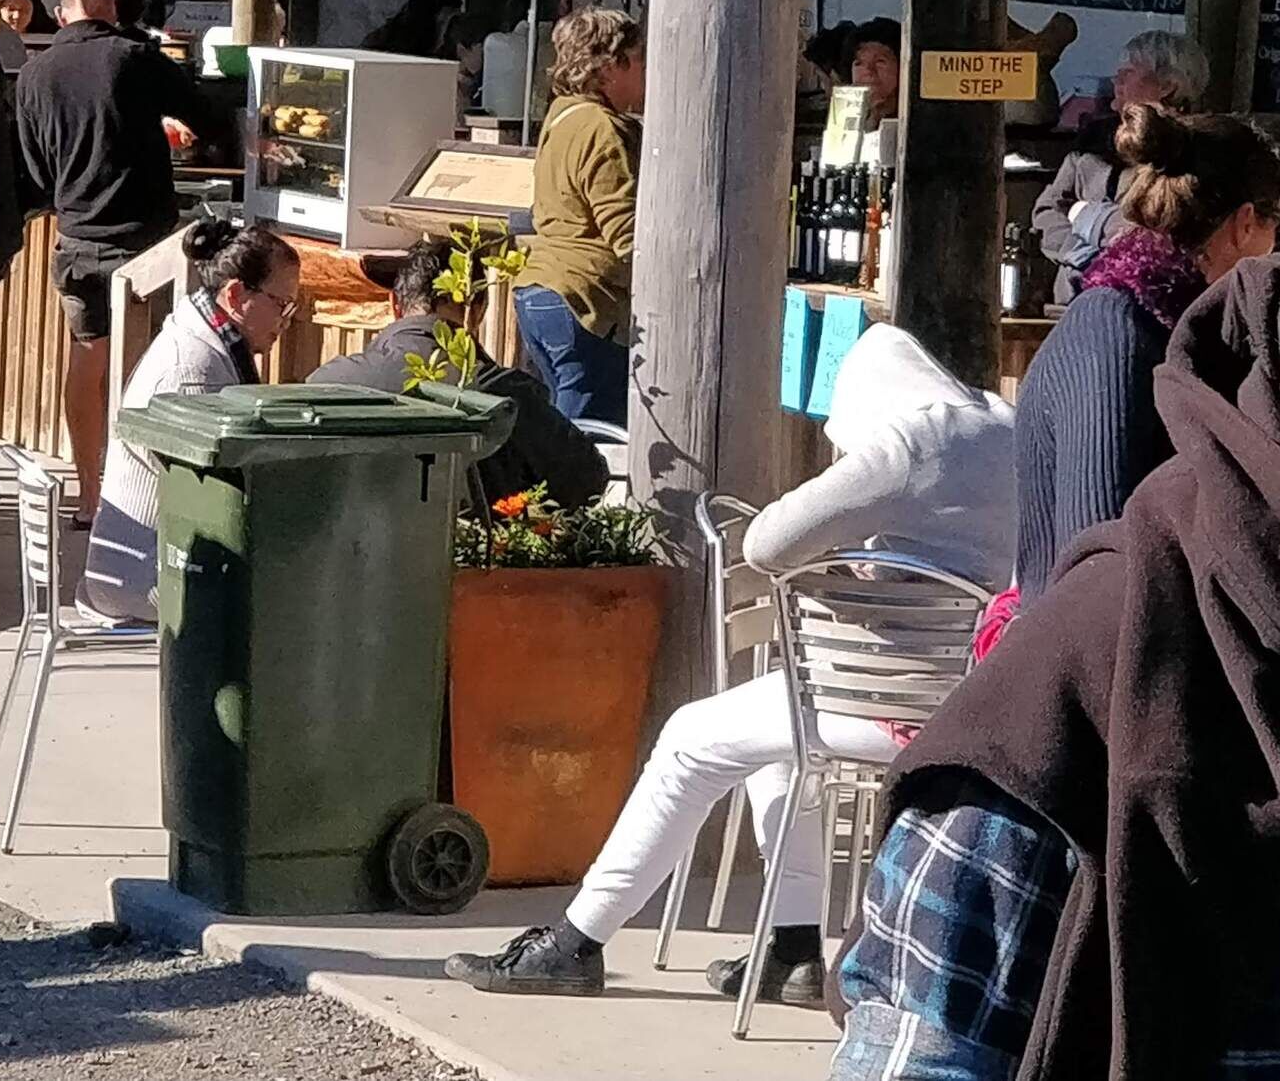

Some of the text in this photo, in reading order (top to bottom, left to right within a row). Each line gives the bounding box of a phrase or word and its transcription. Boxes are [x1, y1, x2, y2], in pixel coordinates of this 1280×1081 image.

[939, 56, 1023, 73] MIND THE
[959, 79, 1003, 94] STEP
